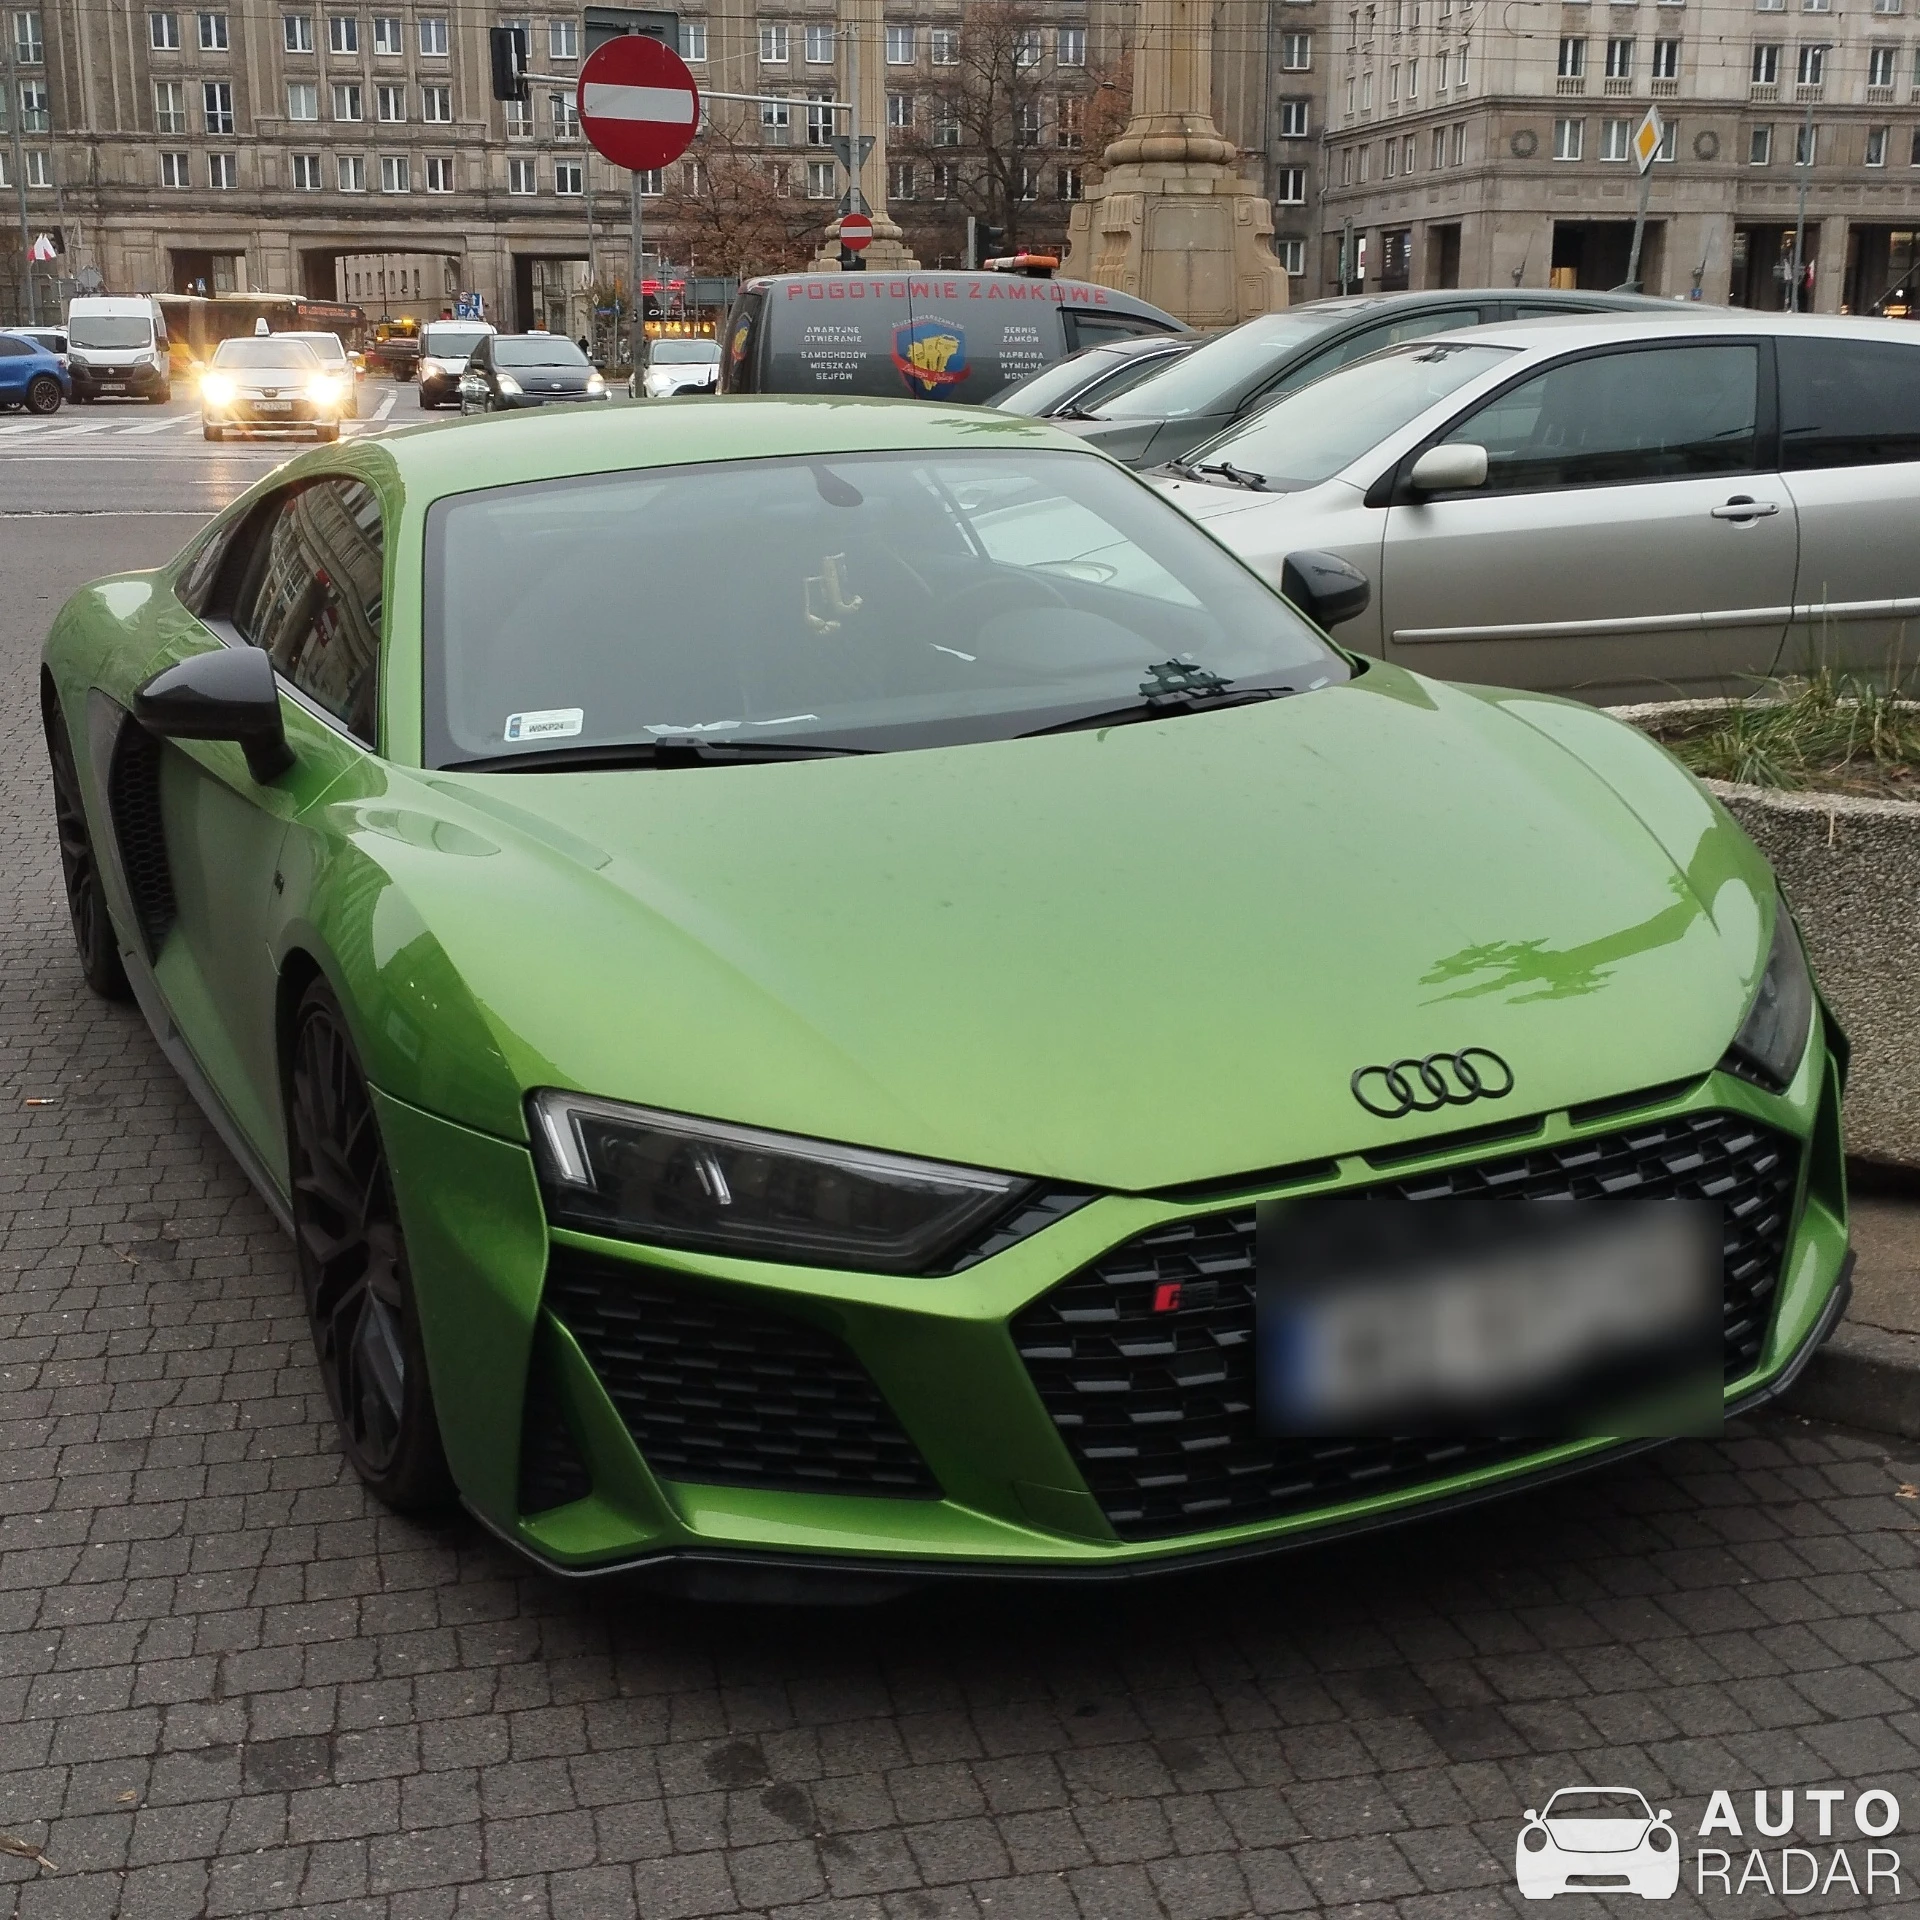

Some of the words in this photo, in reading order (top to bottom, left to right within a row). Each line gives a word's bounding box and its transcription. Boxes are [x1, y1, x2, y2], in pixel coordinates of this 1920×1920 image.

[787, 281, 958, 301] POGOTOWIE
[968, 281, 1108, 305] ZAMKOWE
[1004, 326, 1037, 334] SERWIS
[1002, 335, 1039, 343] ZAMKÓW
[800, 350, 867, 359] SAMOCHODÓW
[999, 351, 1044, 359] NAPRAWA
[1000, 362, 1043, 370] WYMIANA
[815, 371, 853, 380] SEJFÓW
